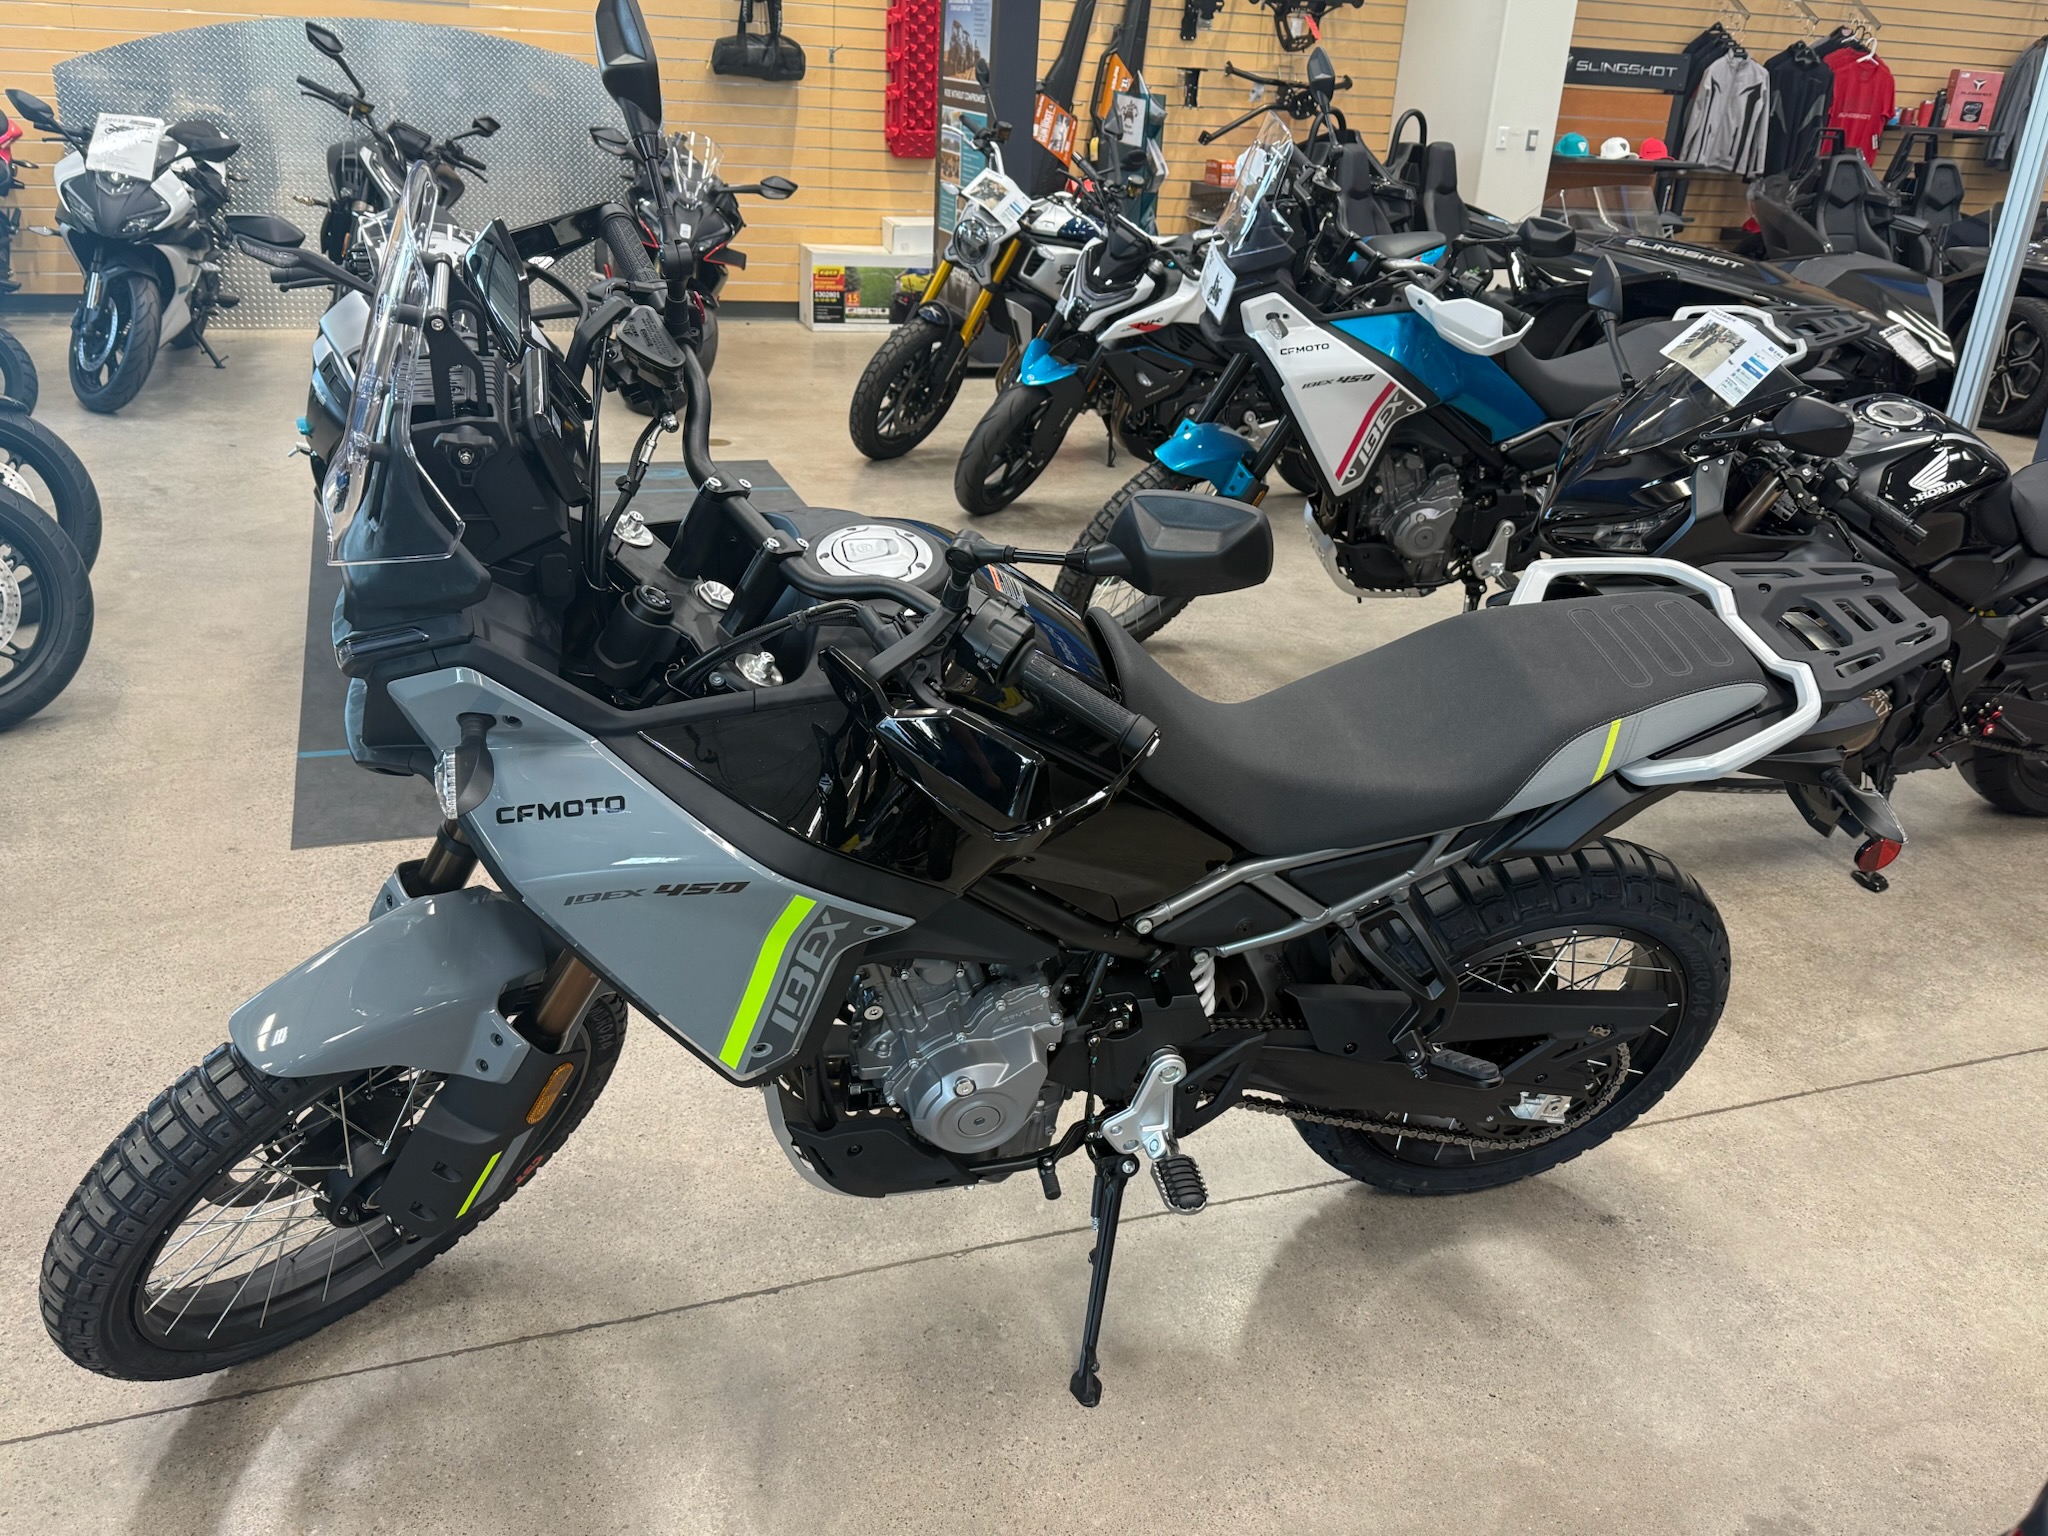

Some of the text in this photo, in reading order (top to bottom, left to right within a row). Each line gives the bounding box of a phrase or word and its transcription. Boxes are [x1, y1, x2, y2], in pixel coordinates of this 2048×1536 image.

[1576, 60, 1678, 77] SLINGSHOT
[1625, 238, 1745, 269] SLINGSHOT
[848, 295, 858, 303] 15
[1280, 343, 1330, 356] CFMOTO
[1301, 373, 1376, 390] IBEX 450
[1358, 392, 1405, 466] IBEX
[1915, 479, 1968, 502] HONDA
[496, 795, 626, 825] CFMOTO
[563, 881, 751, 906] IBEX 450
[771, 911, 851, 1034] IBEX
